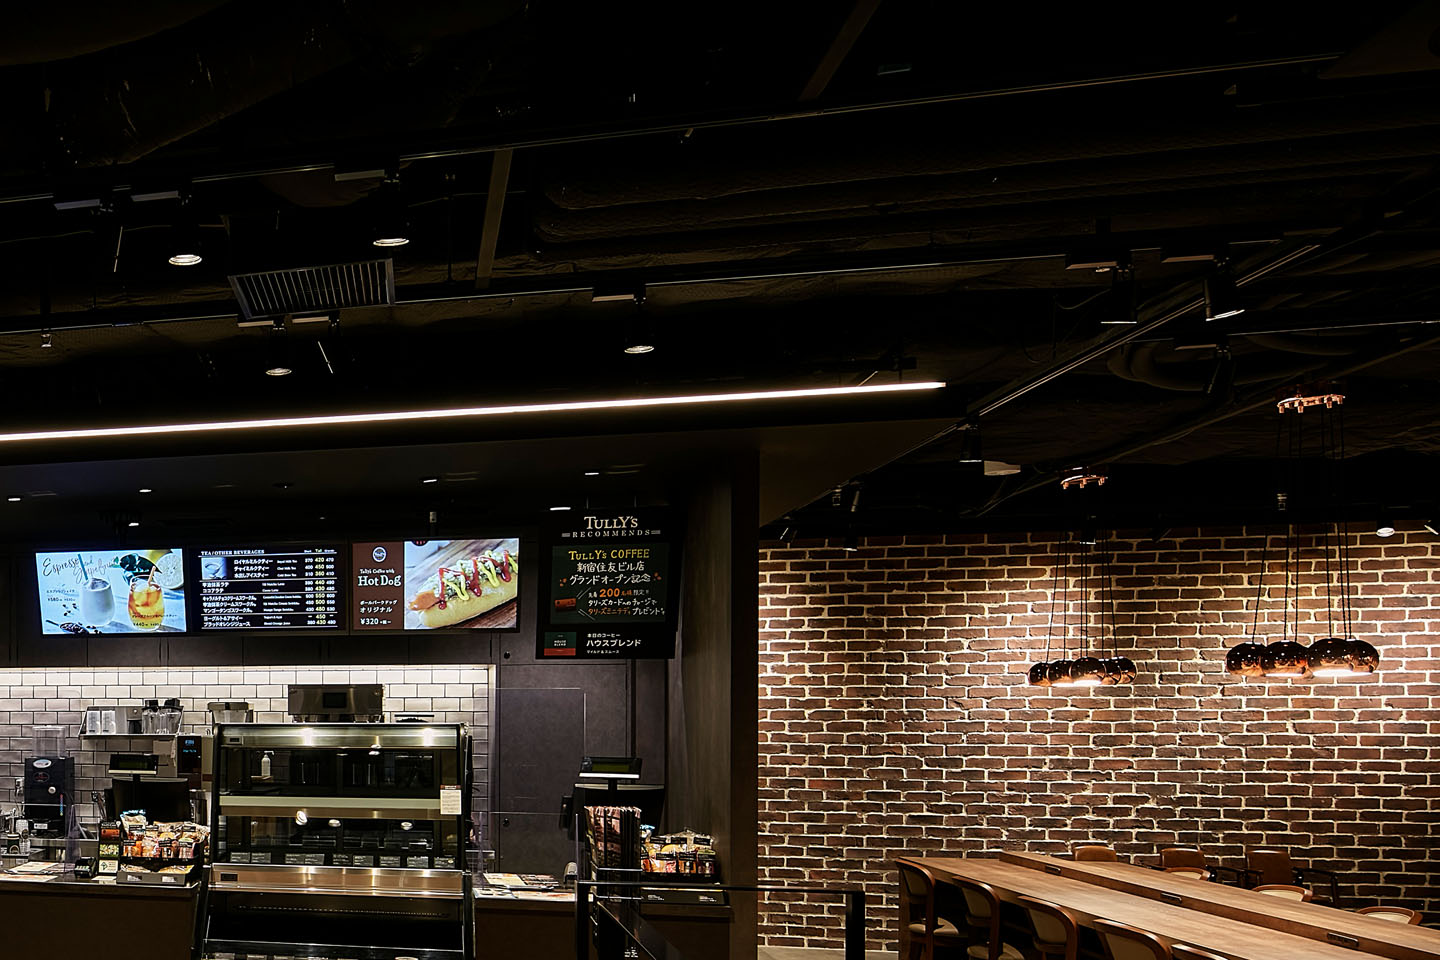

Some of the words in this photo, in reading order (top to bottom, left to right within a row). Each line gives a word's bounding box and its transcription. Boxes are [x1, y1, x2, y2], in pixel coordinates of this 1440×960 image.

[572, 529, 650, 538] RECOMMENDS
[610, 549, 650, 559] COFFEE
[576, 561, 645, 573] 新宿住友ビル店
[358, 576, 380, 586] Hot
[380, 574, 402, 586] Dog
[569, 573, 651, 585] グランドオープン記念
[586, 639, 641, 647] ハウスブレンド
